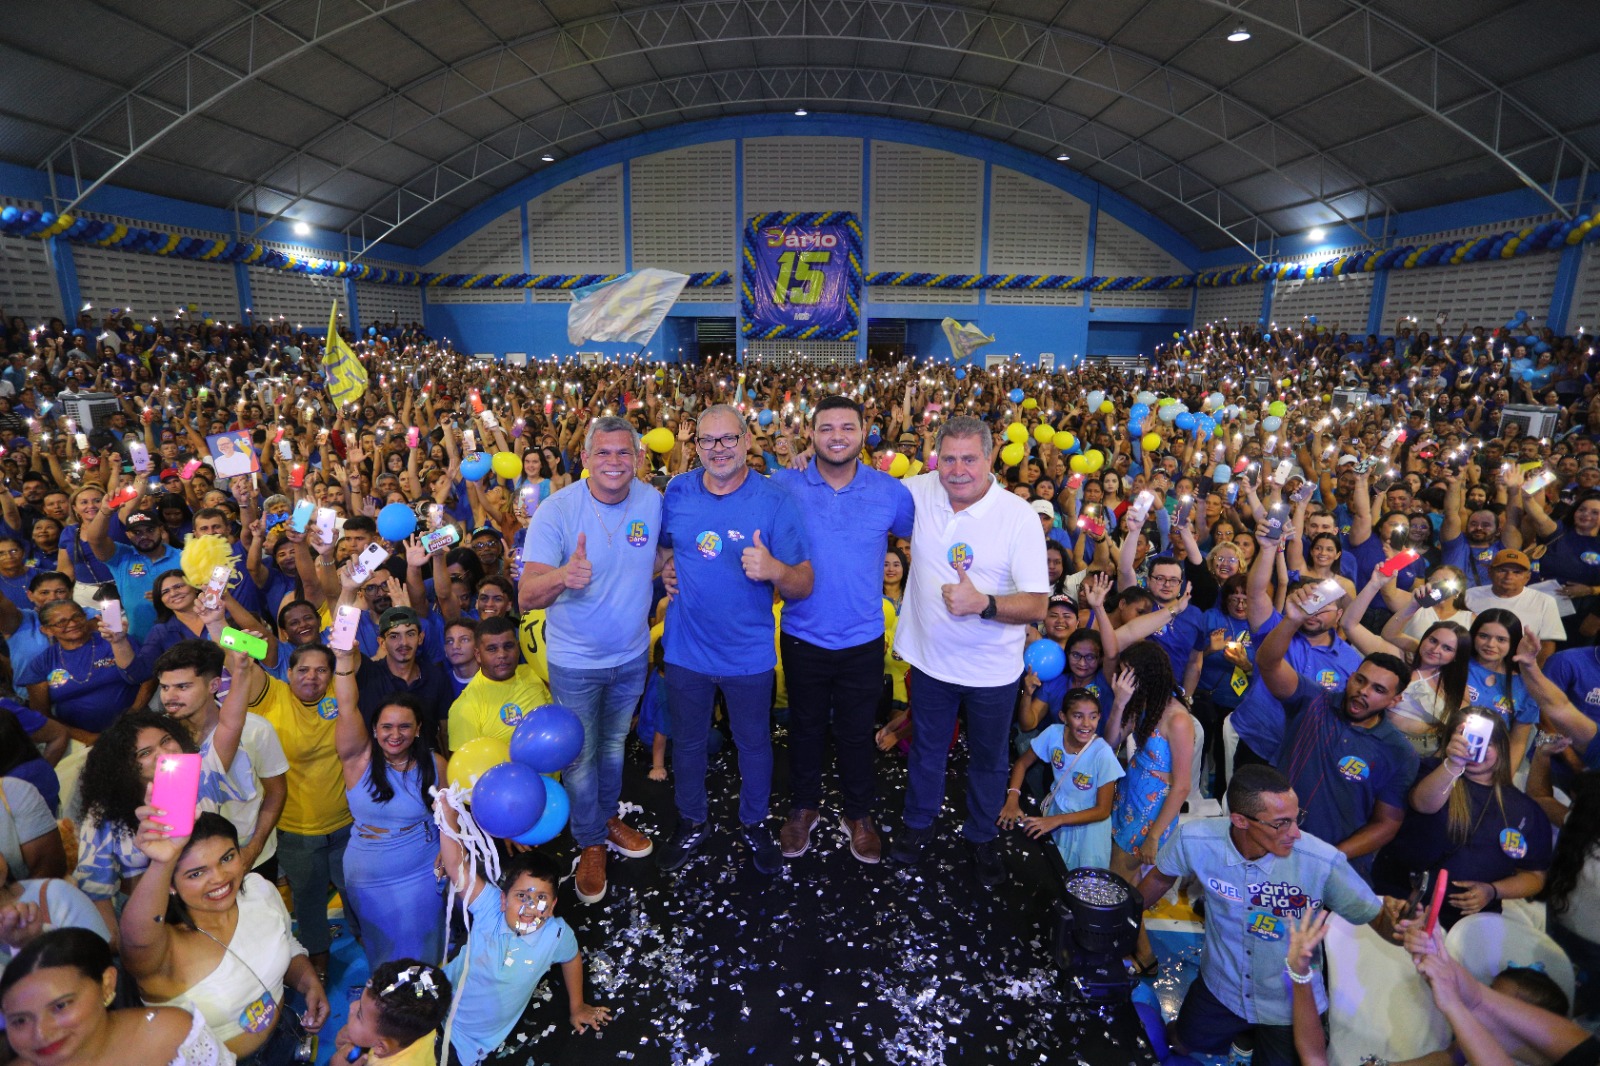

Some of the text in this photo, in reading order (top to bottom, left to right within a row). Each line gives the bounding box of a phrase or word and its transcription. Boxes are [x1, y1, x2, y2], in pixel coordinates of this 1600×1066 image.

[767, 228, 837, 247] Dário
[773, 251, 830, 304] 15
[631, 522, 645, 537] 15
[701, 533, 719, 550] 15
[952, 543, 966, 561] 15
[1322, 671, 1335, 683] 15
[1344, 758, 1366, 775] 15
[1505, 831, 1520, 848] 15
[1210, 879, 1242, 899] QUEL
[1248, 881, 1300, 896] Dário
[1254, 914, 1277, 931] 15
[246, 999, 264, 1023] 15
